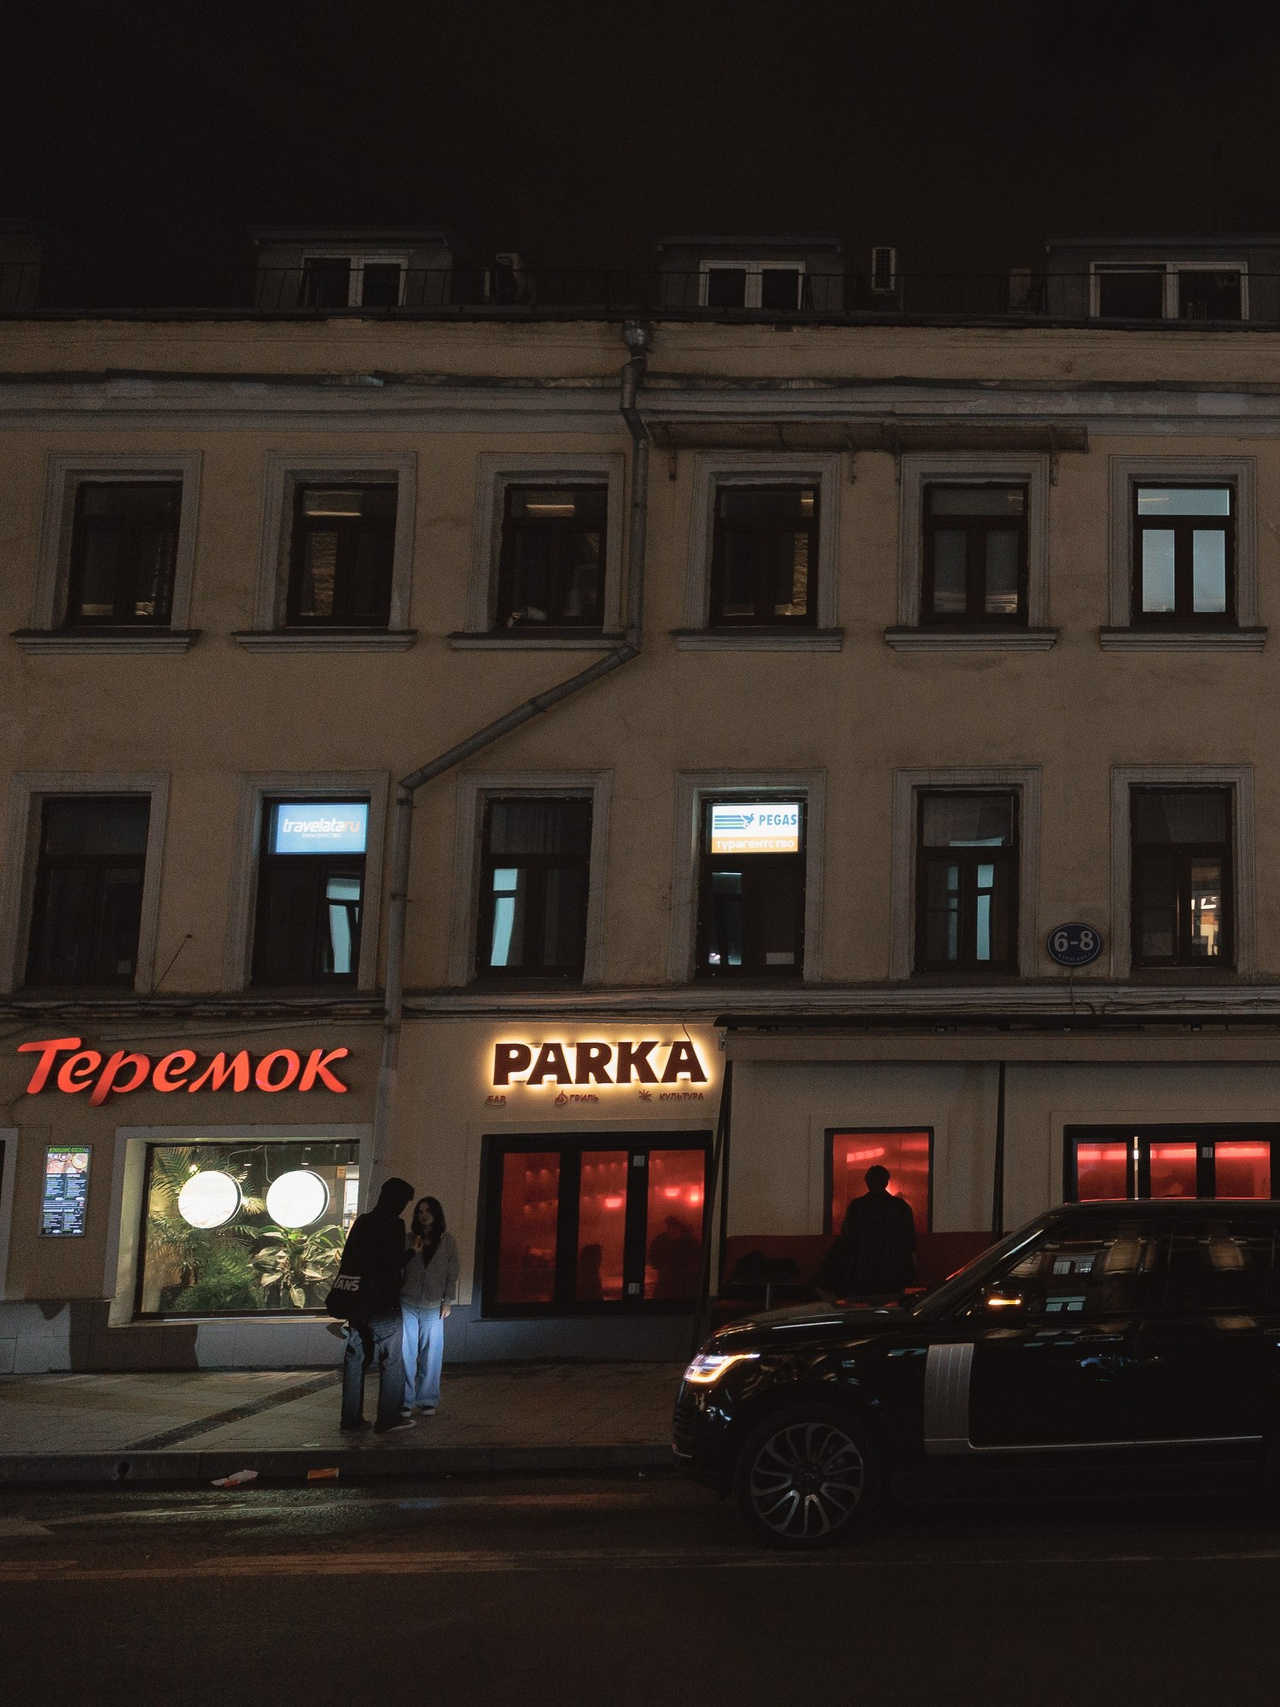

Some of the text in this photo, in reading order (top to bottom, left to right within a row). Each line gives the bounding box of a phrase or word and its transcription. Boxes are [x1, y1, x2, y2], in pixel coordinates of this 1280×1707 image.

[758, 814, 797, 826] PEGAS
[716, 839, 795, 851] турагентство
[1054, 930, 1094, 952] 6-8
[493, 1041, 708, 1085] PARKA
[17, 1037, 348, 1107] Теремок
[487, 1092, 704, 1103] БАР ГРИЛЬ КУЛЬТУРА
